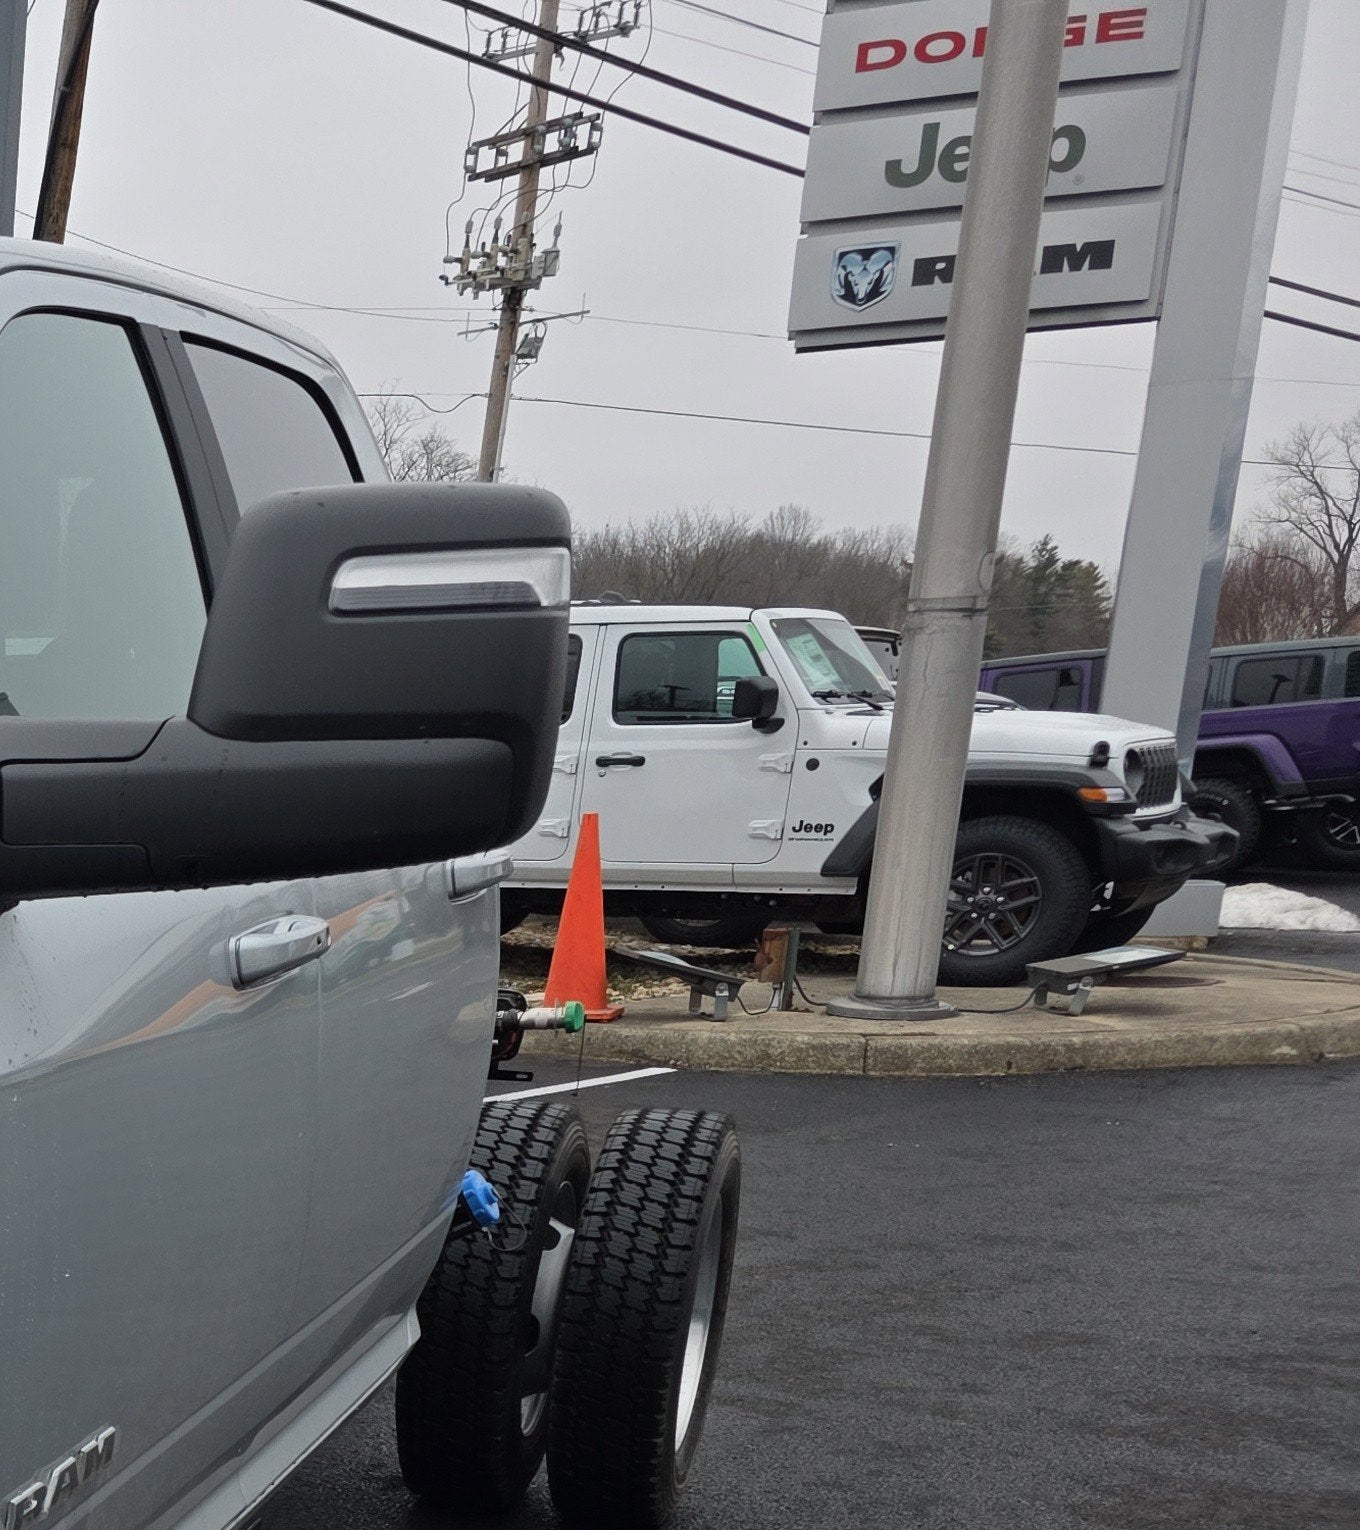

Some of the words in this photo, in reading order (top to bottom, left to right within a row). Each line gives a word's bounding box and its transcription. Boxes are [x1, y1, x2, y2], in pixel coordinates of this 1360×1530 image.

[885, 121, 1087, 188] Jep
[911, 239, 1116, 287] RM
[791, 819, 835, 836] Jeep
